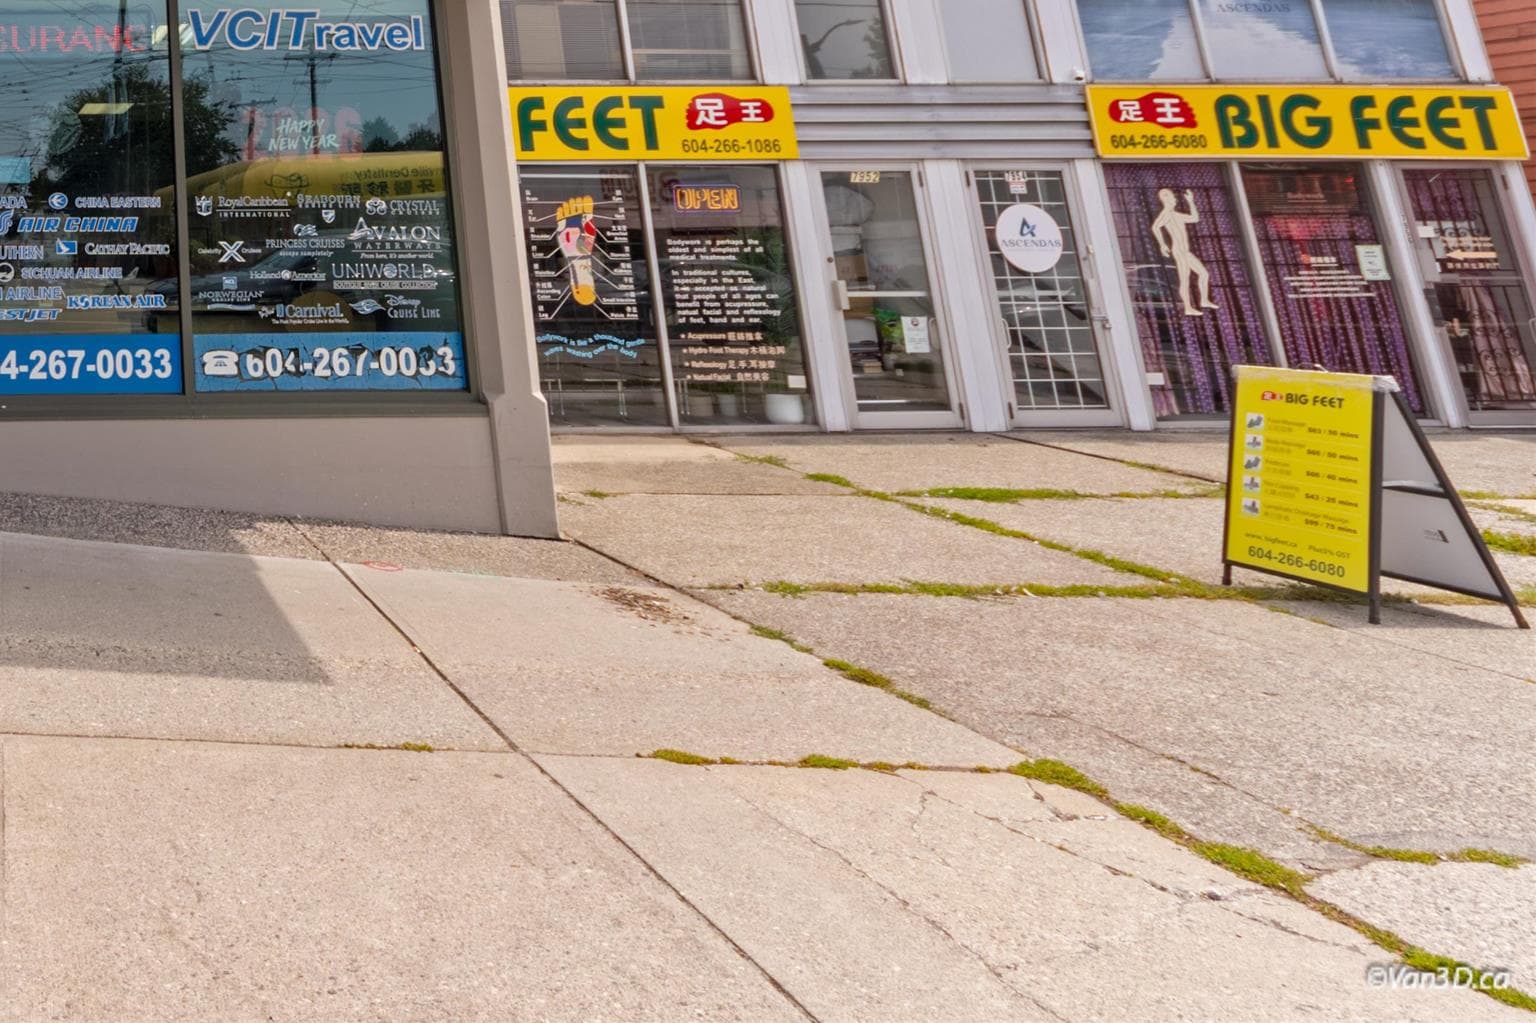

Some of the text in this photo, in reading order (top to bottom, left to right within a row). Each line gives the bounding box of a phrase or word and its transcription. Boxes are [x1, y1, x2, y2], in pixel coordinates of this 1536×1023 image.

[1216, 2, 1290, 13] ASCENDAS
[694, 97, 765, 126] 足王
[1117, 97, 1185, 124] 足王
[277, 117, 325, 135] HAPPY
[518, 95, 664, 152] FEET
[1214, 93, 1498, 151] BIG FEET
[268, 134, 340, 152] NEW YEAR
[681, 138, 782, 154] 604-266-1086
[1110, 135, 1207, 149] 604-266-6080
[75, 196, 162, 208] CHINA EASTERN
[390, 199, 440, 211] CRYSTAL
[676, 187, 739, 210] OPEN
[16, 216, 139, 232] AIR CHINA
[265, 238, 345, 248] PRINCESS CRUISES
[1000, 239, 1061, 248] ASCENDAS
[21, 267, 123, 279] SICHUAN AIRLINE
[249, 270, 280, 279] Holland
[135, 294, 167, 309] AIR
[199, 291, 263, 299] NORWEGIAN
[1285, 393, 1309, 405] BIG
[1312, 395, 1344, 409] FEET
[1248, 545, 1346, 578] 604-266-6080
